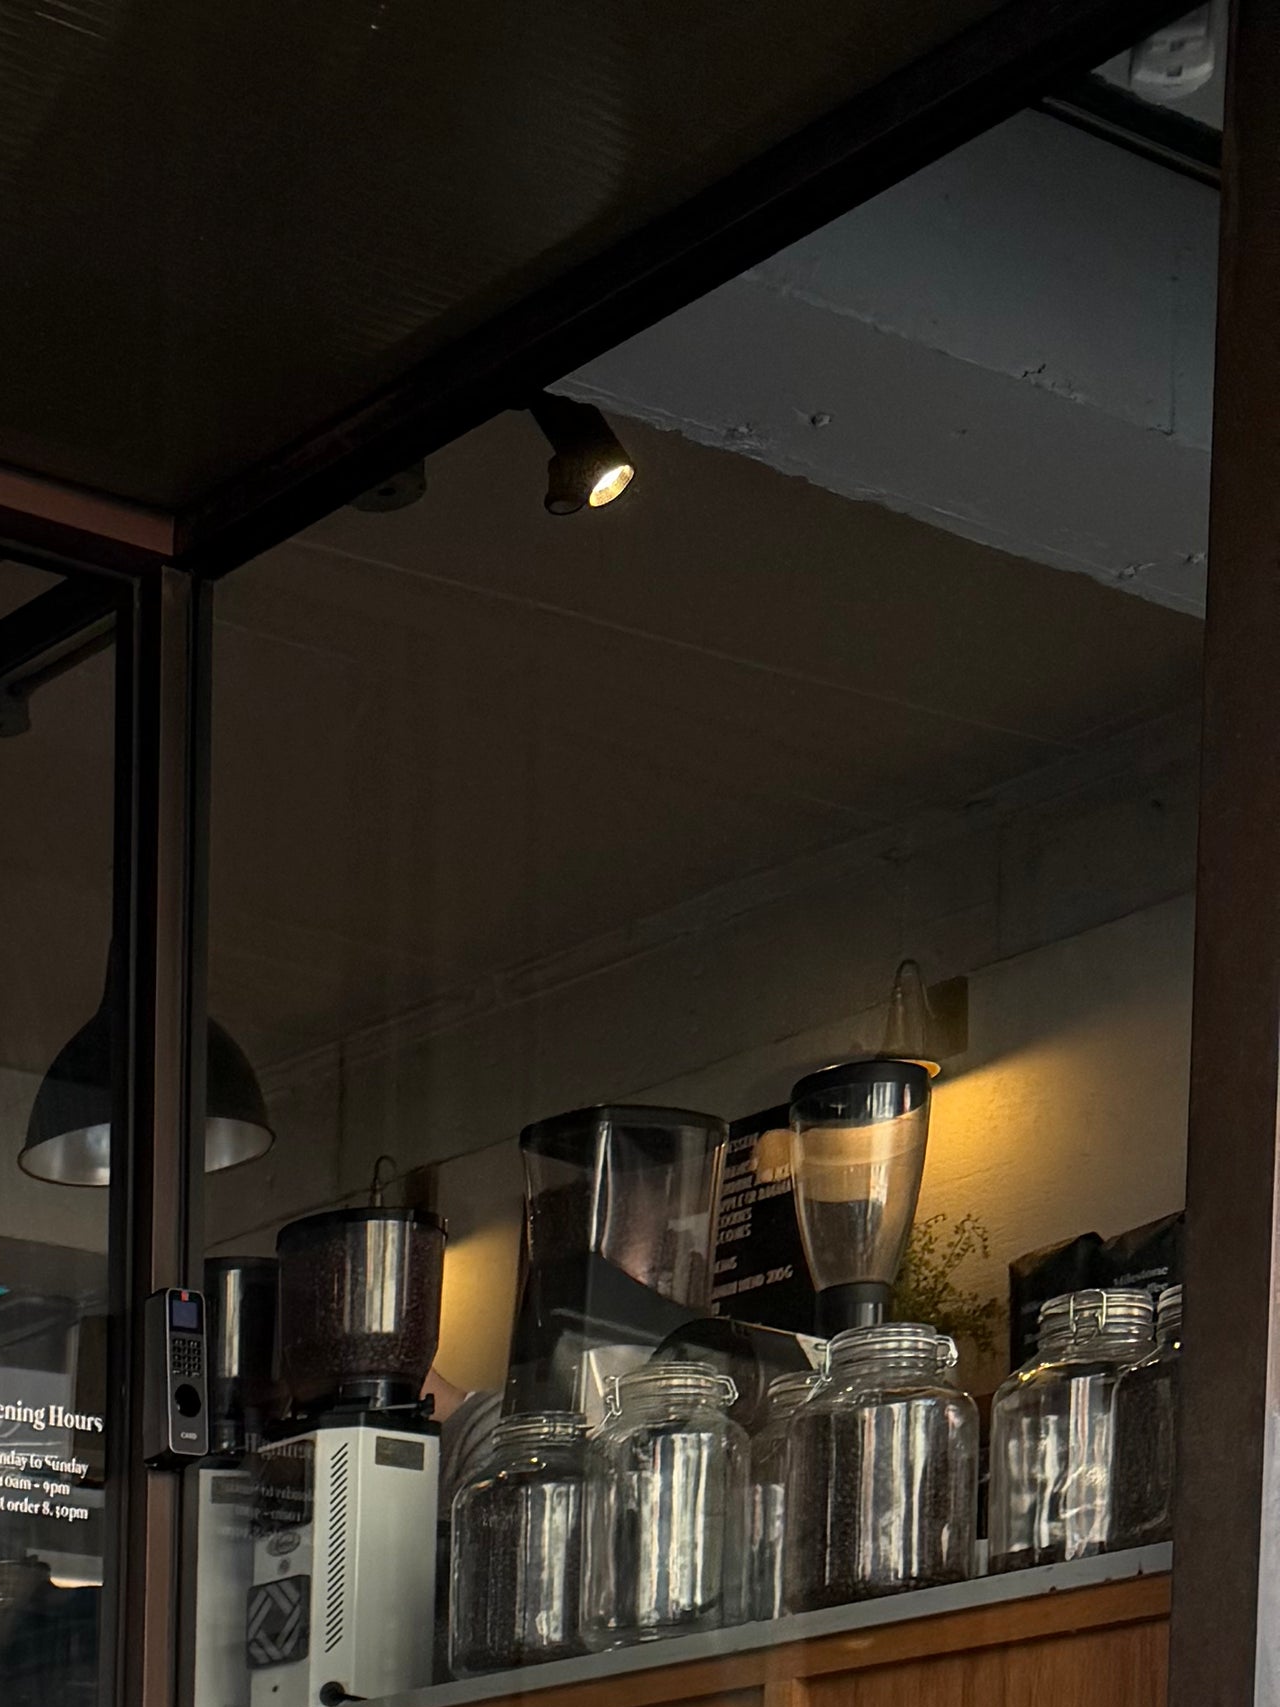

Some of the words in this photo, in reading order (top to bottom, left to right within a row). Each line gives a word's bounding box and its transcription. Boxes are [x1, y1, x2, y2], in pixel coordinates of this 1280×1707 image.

[49, 1405, 104, 1433] Hours
[29, 1455, 43, 1469] to
[44, 1455, 90, 1480] Sunday
[43, 1482, 70, 1497] 9pm
[6, 1497, 39, 1514] order
